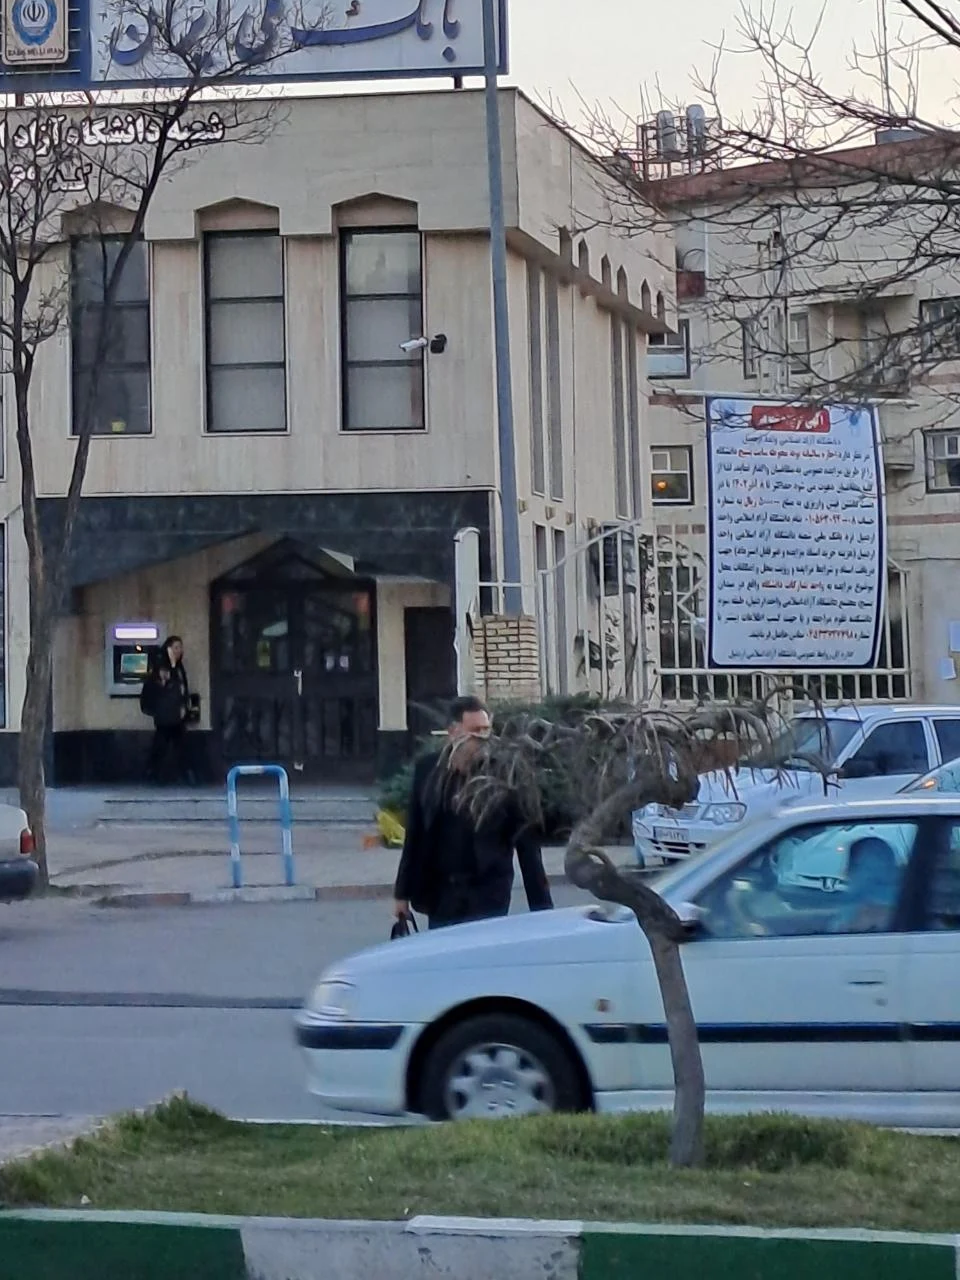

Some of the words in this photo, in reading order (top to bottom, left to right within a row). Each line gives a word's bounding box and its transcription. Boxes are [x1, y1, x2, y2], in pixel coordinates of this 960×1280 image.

[14, 114, 67, 157] آزاد
[67, 114, 160, 145] دانشگاه
[166, 112, 225, 150] شعبه
[47, 163, 92, 192] کد
